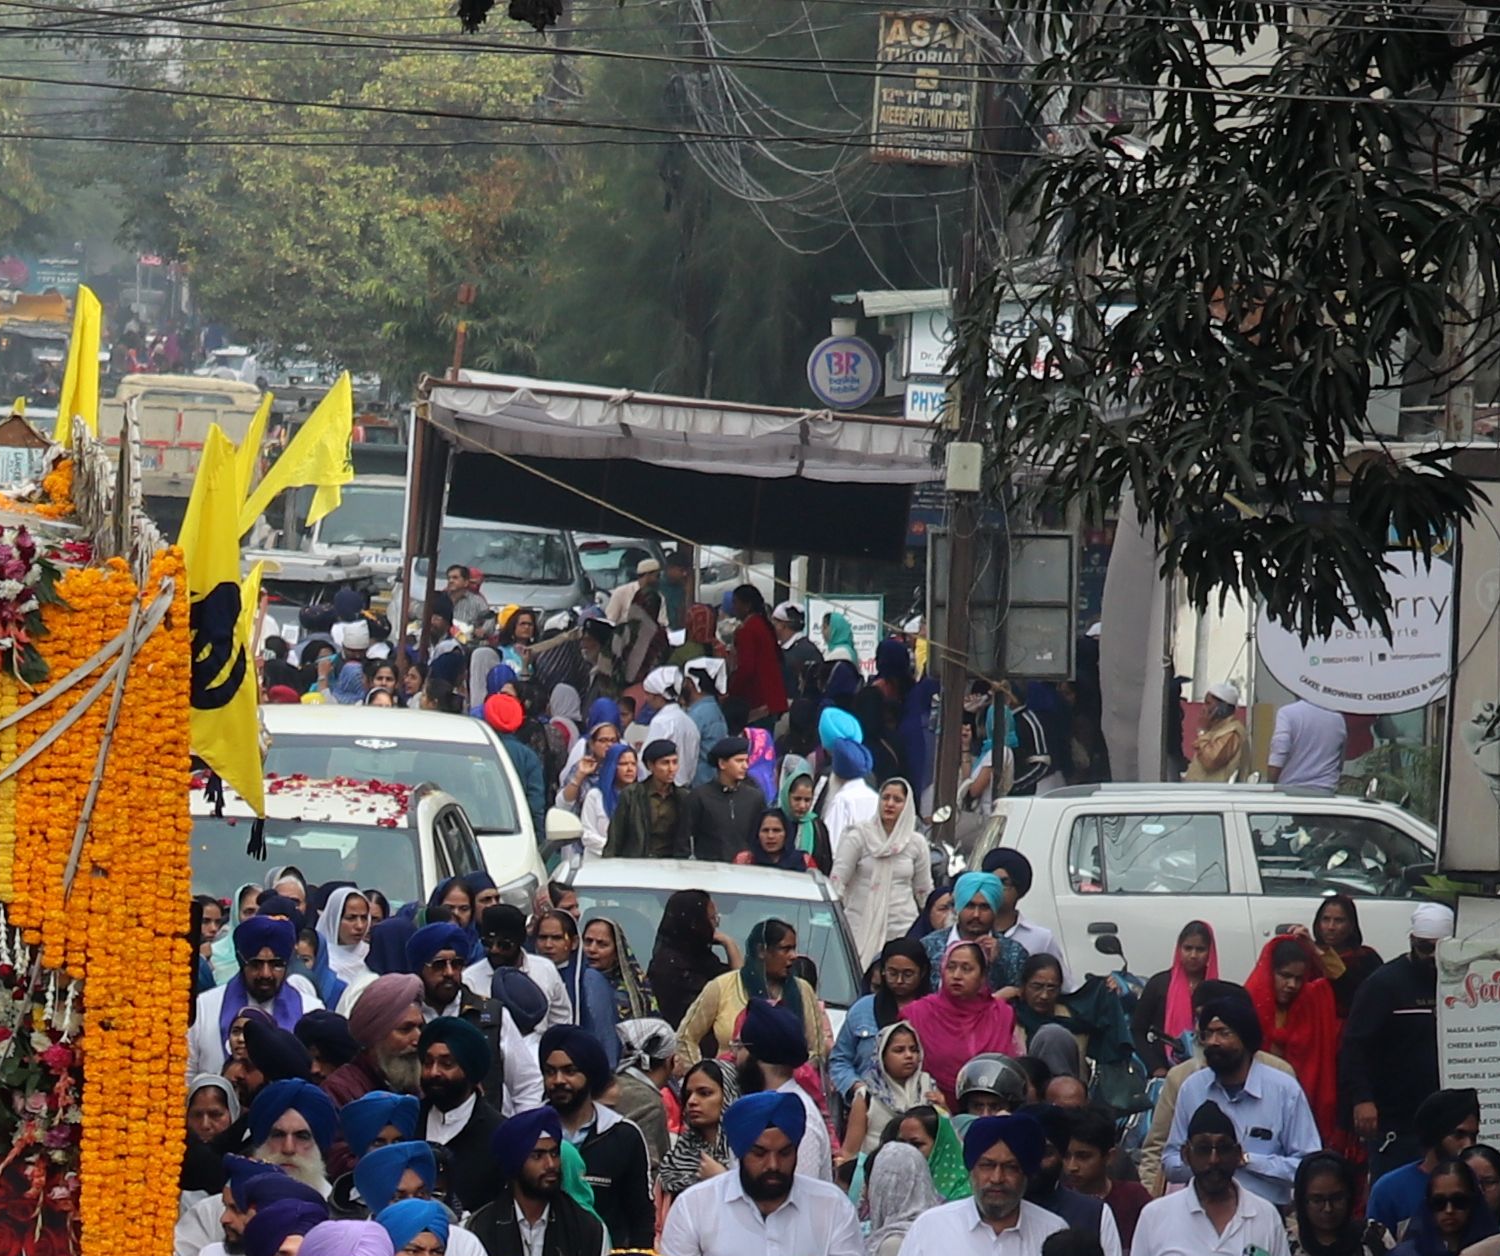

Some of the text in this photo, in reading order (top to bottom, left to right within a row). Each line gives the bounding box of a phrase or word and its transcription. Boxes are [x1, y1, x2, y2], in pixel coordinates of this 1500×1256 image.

[825, 351, 861, 376] BR
[852, 624, 877, 632] ealth
[1335, 627, 1419, 640] Patissrie
[1322, 685, 1363, 700] BROWNIES
[1367, 685, 1420, 700] CHEESECAKES
[1447, 1041, 1473, 1049] CHEESE
[1475, 1040, 1498, 1048] BAKED
[1448, 1057, 1476, 1065] BOMBAY
[1448, 1072, 1486, 1080] VEGETABLE
